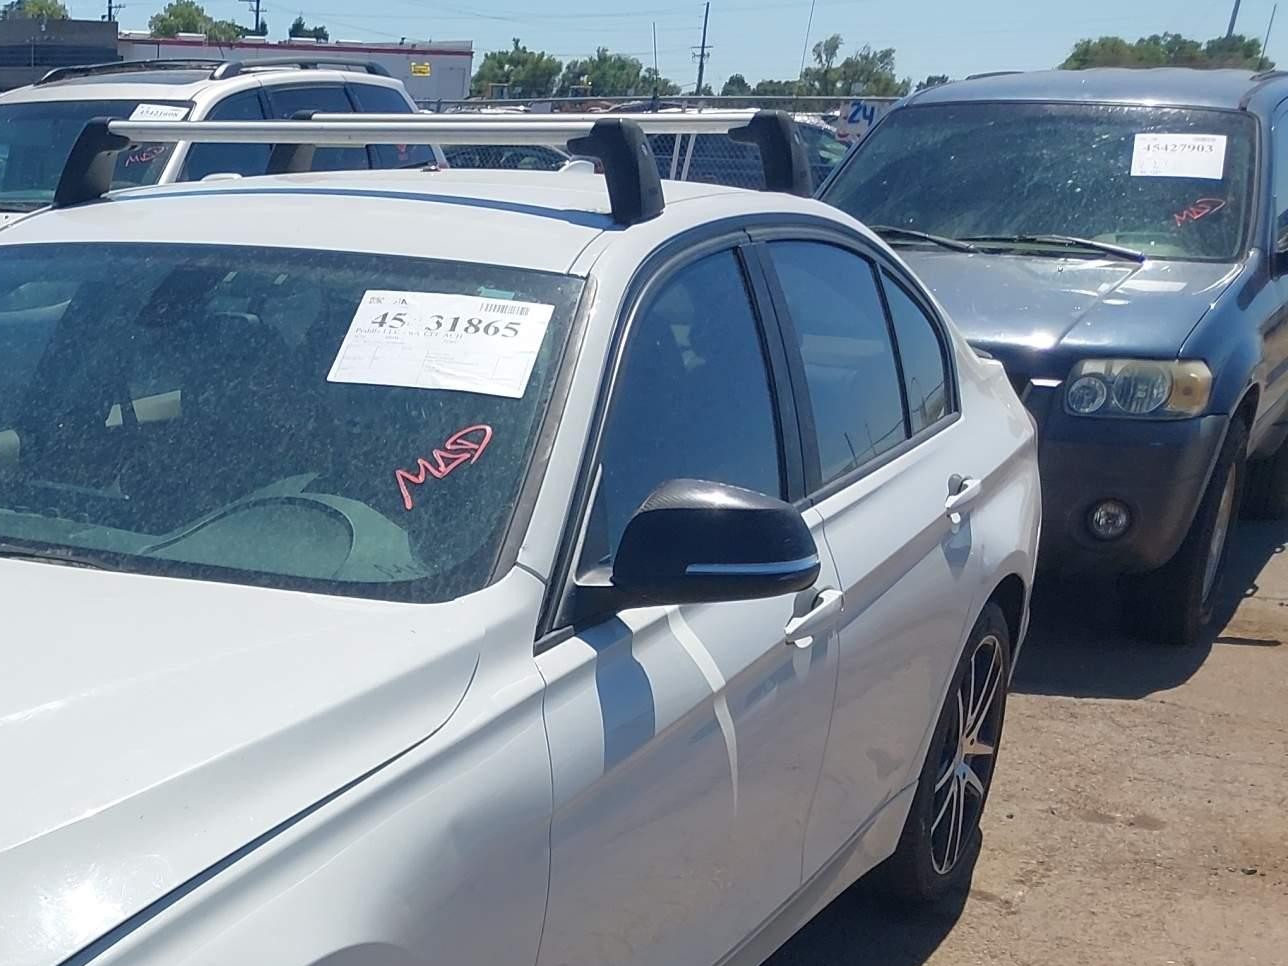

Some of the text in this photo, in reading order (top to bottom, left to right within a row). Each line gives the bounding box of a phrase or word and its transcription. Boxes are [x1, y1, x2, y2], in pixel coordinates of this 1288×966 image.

[848, 100, 875, 126] 24
[1144, 143, 1214, 153] 45427903
[371, 311, 522, 339] 4531865
